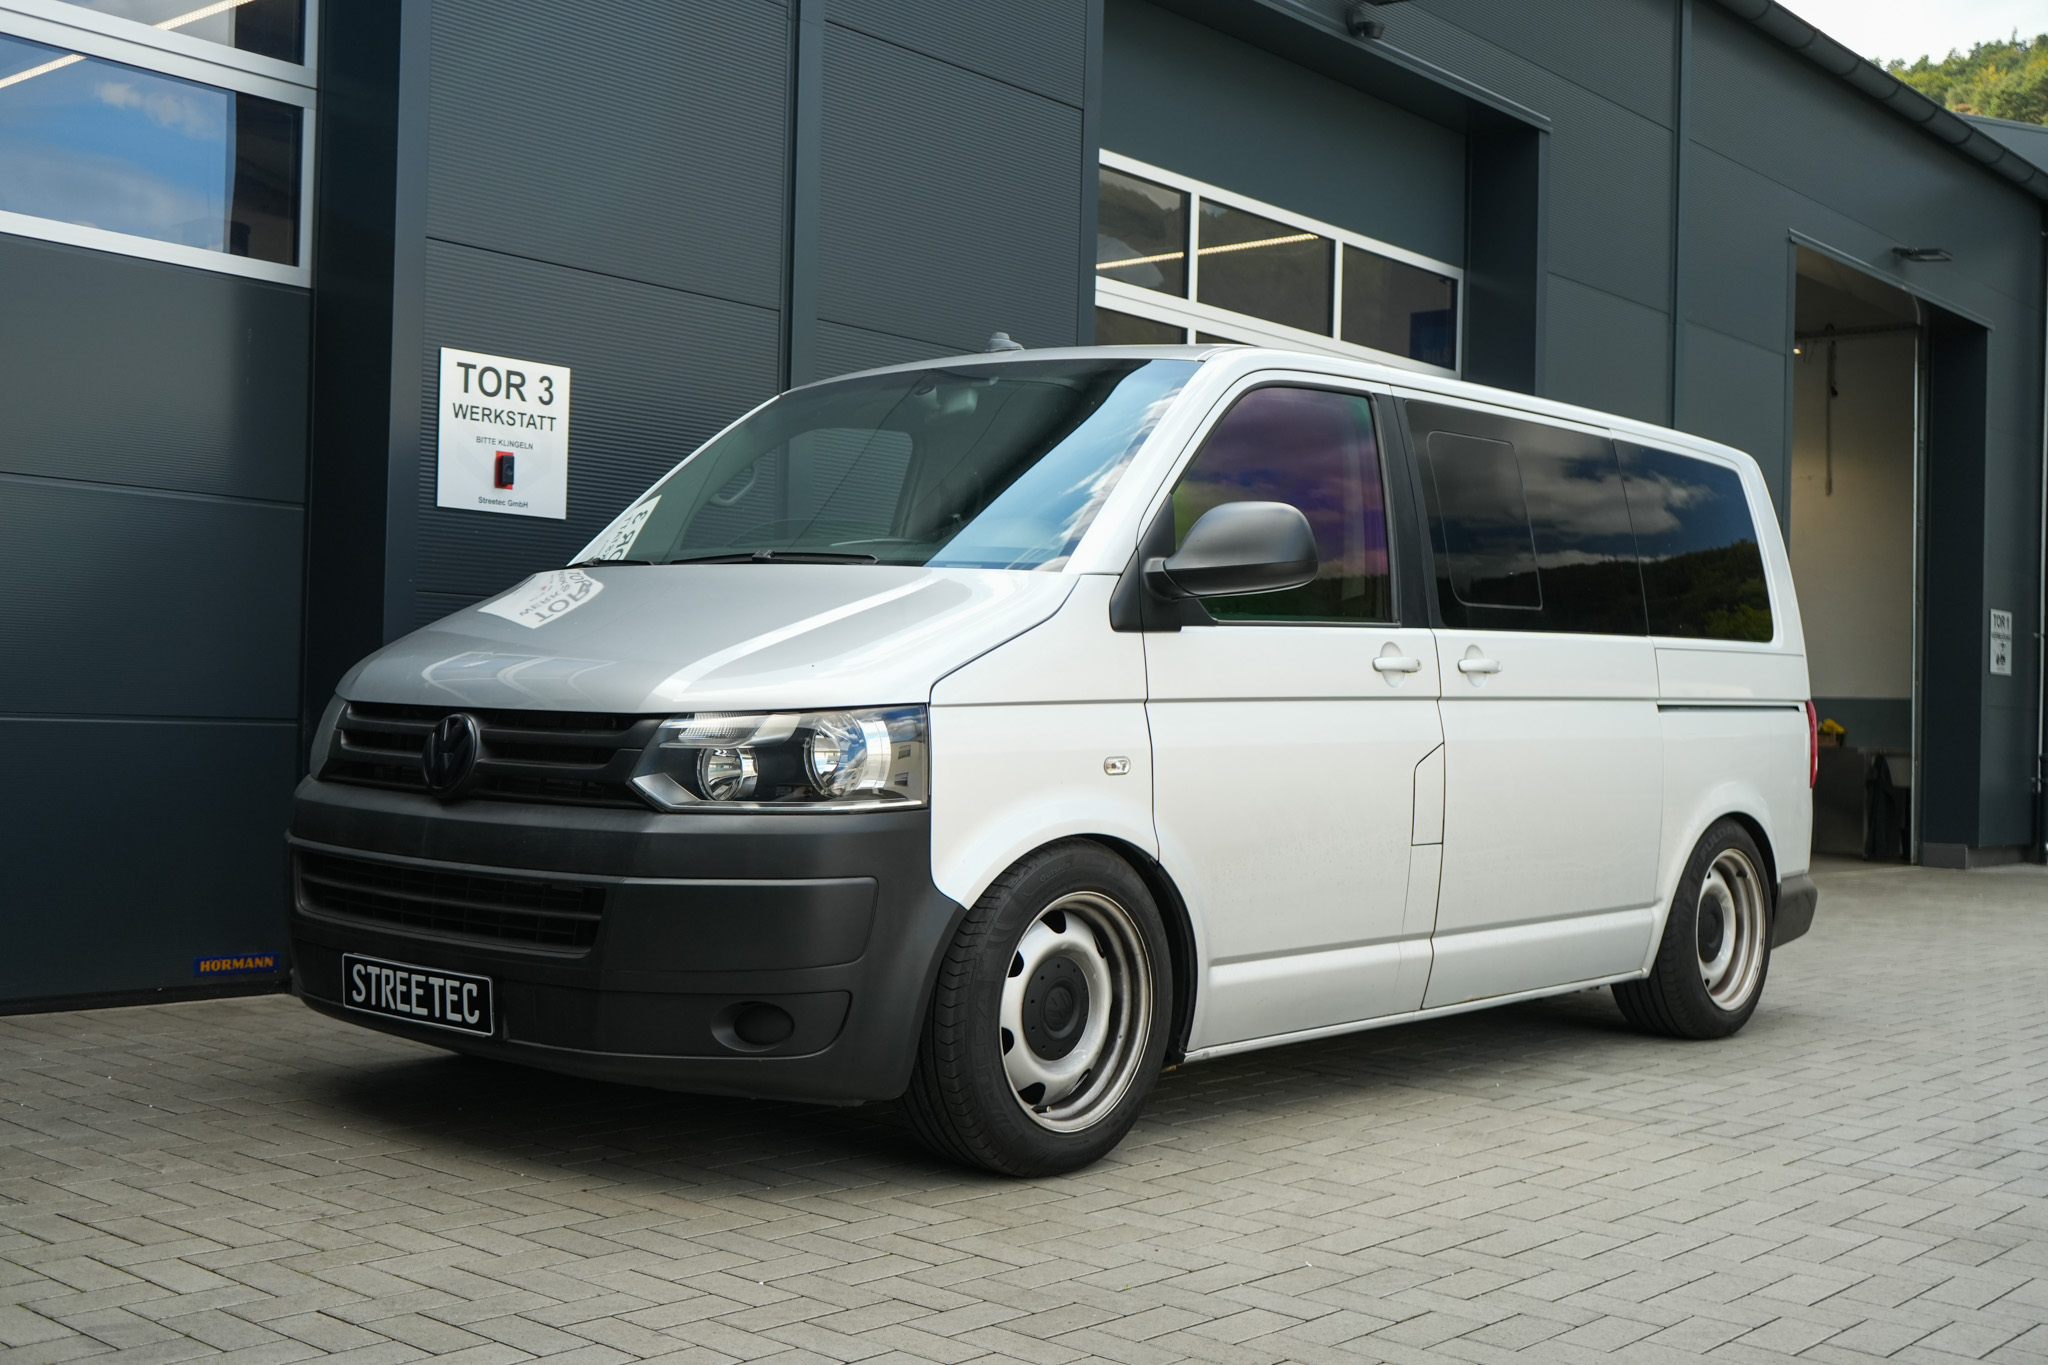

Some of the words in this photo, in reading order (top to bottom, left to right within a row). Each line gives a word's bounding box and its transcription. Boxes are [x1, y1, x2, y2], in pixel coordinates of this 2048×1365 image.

[456, 361, 527, 403] TOR
[537, 375, 554, 406] 3
[452, 402, 557, 432] WERKSTATT
[476, 436, 496, 446] BITTE
[498, 439, 534, 450] KLINGELN
[478, 496, 506, 507] Streetec
[507, 499, 529, 509] GmbH
[1993, 614, 2006, 629] TOR
[1039, 860, 1072, 882] Outside
[200, 956, 275, 973] HÖRMANN
[352, 963, 480, 1025] STREETEC
